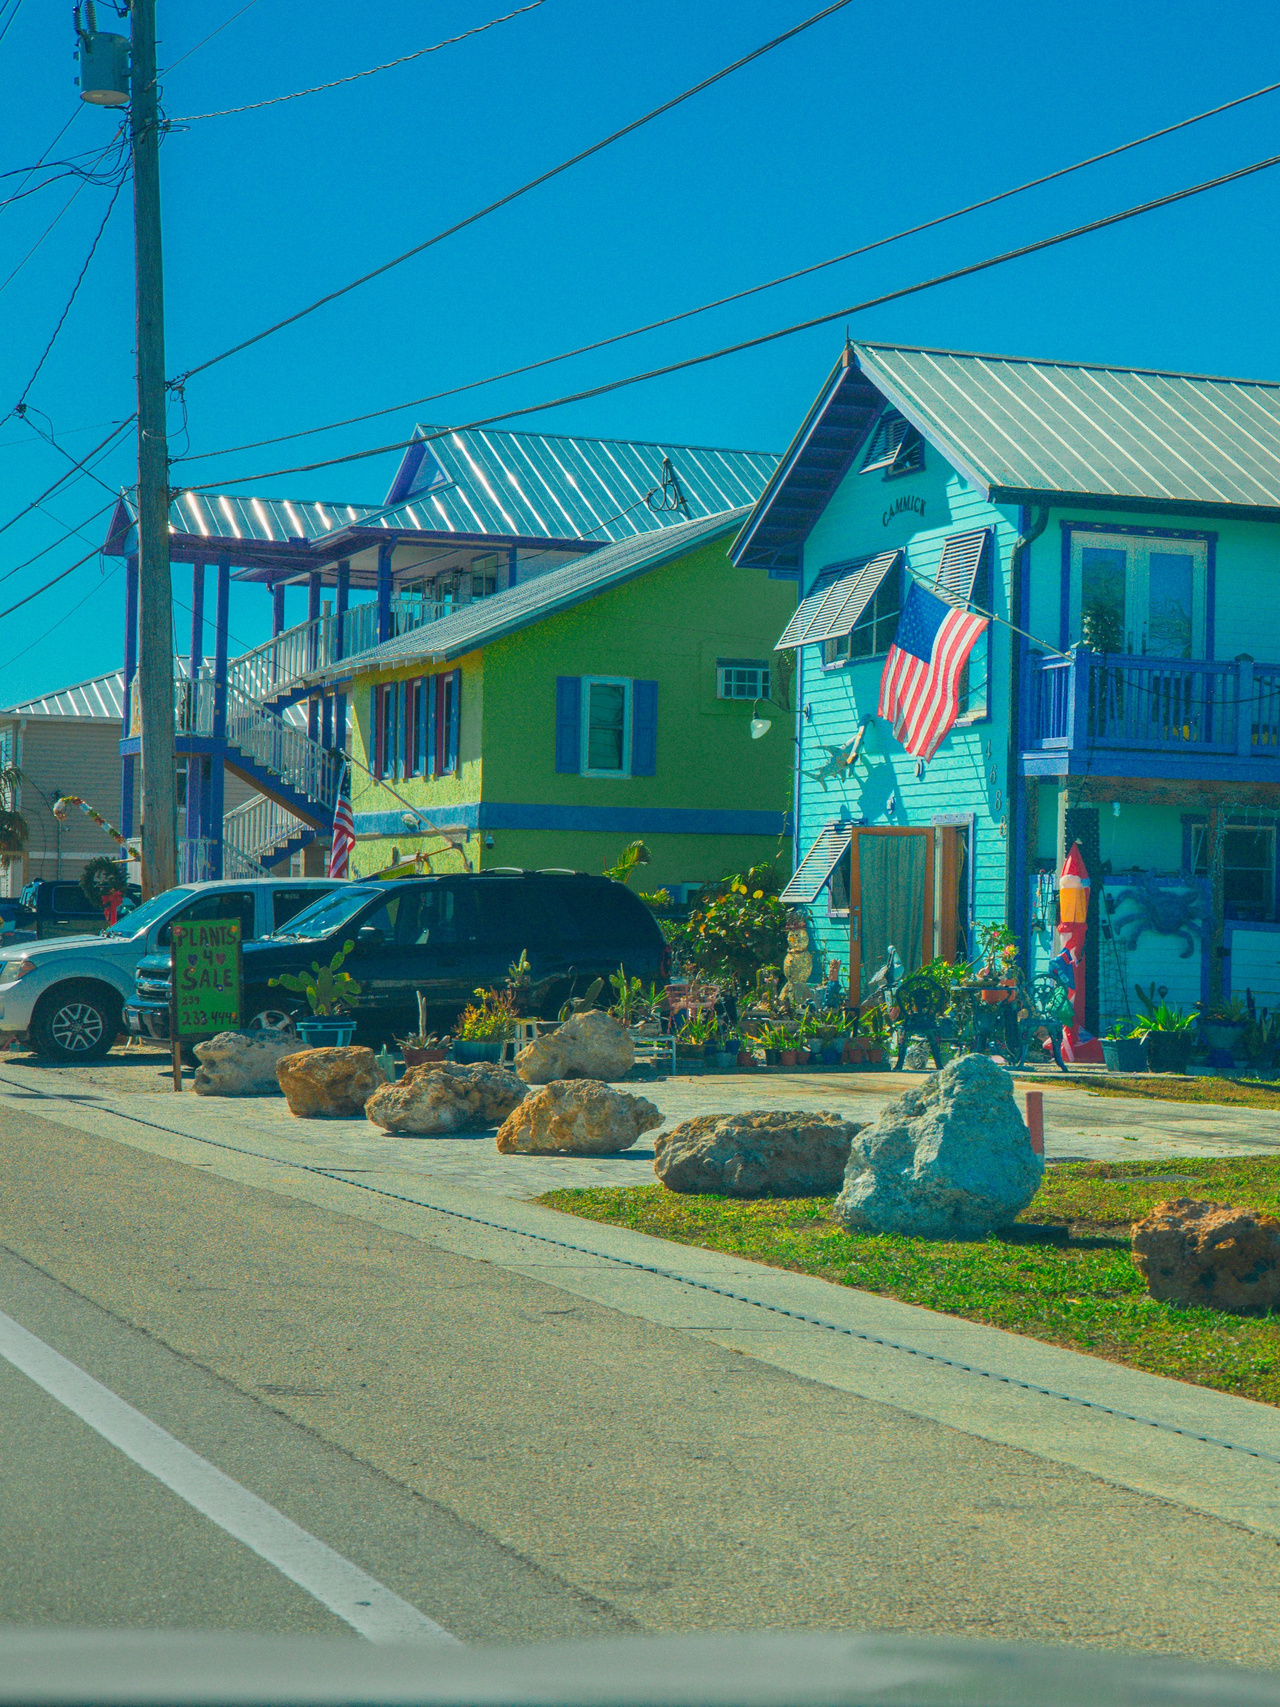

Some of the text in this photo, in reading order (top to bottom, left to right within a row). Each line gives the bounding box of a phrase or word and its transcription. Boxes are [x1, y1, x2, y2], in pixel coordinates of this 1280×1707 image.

[882, 495, 926, 527] CAMMICK
[985, 740, 1006, 837] 4688
[176, 925, 237, 947] PLANTS
[203, 950, 213, 966] 4
[181, 968, 234, 991] SALE
[182, 996, 199, 1006] 239
